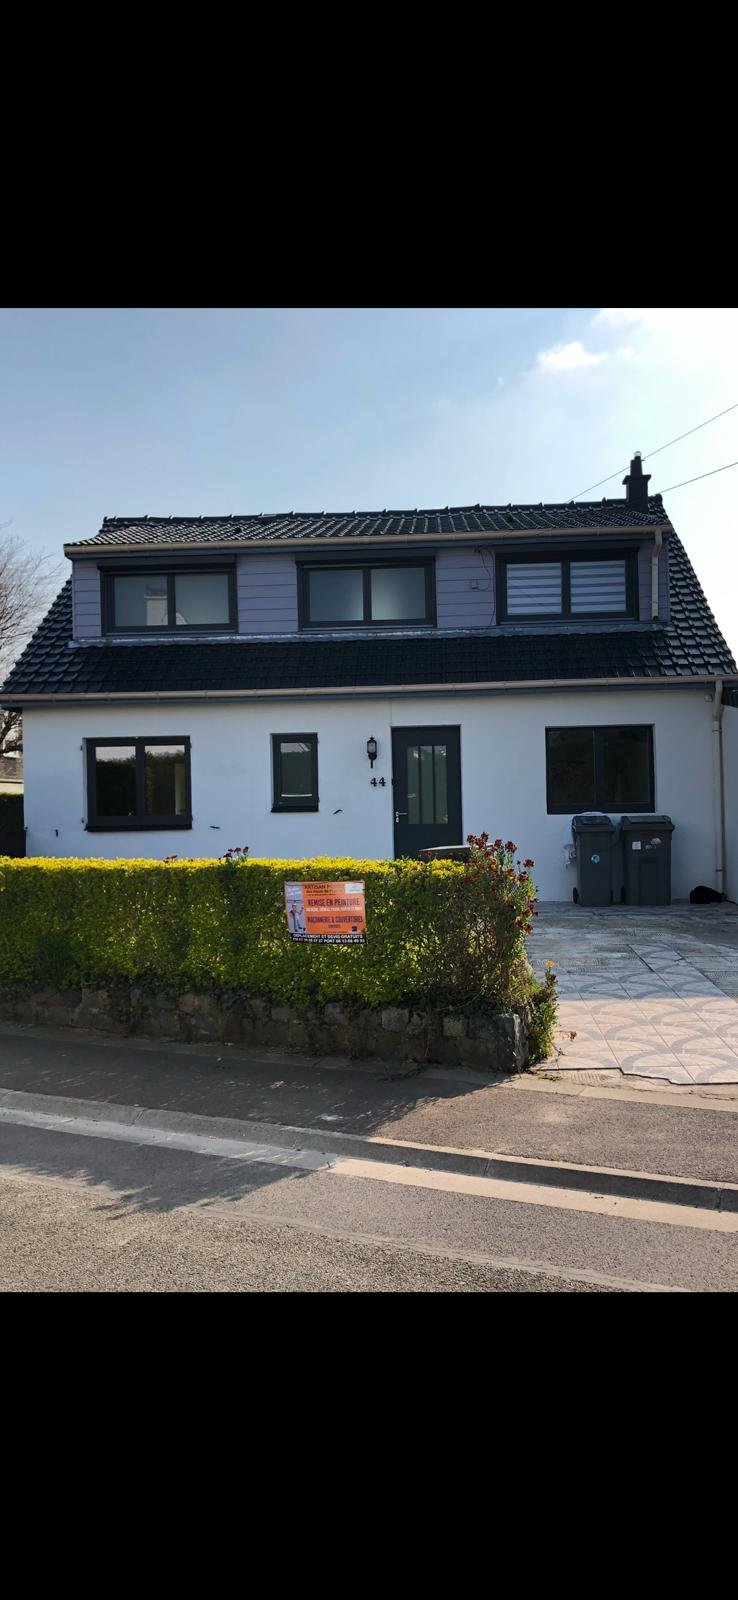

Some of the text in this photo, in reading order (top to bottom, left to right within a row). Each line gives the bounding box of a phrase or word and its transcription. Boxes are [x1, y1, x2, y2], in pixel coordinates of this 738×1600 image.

[370, 777, 386, 787] 44
[308, 899, 325, 907] REMISE
[334, 898, 360, 906] PEINTURE
